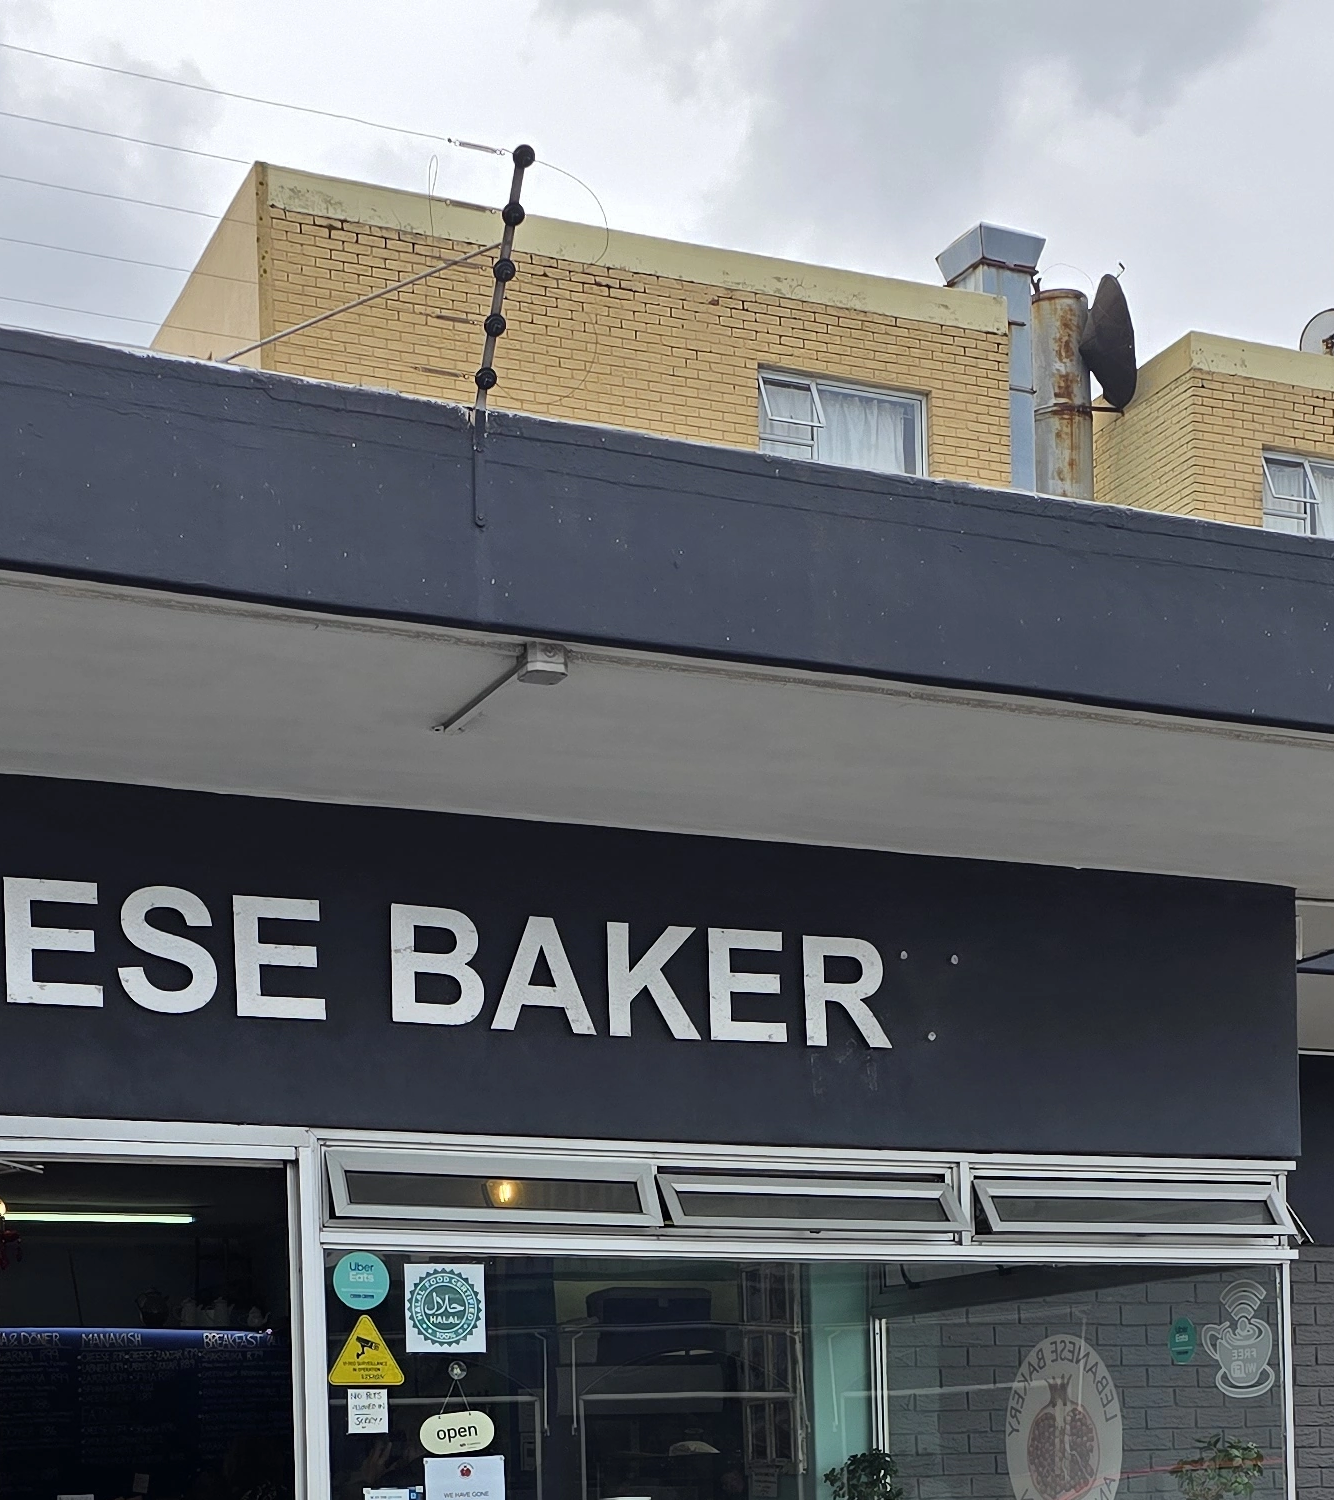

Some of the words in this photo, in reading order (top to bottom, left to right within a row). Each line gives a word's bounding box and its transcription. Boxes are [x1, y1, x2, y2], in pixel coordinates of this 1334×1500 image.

[390, 903, 893, 1049] BAKER
[349, 1261, 375, 1272] Uber
[349, 1272, 375, 1283] Eats
[424, 1276, 450, 1289] FOOD
[424, 1291, 465, 1315] حلال
[429, 1315, 462, 1325] HALAL
[80, 1332, 143, 1348] MANAKISH
[203, 1333, 265, 1349] BREAKFAST
[436, 1425, 478, 1443] open
[471, 1490, 490, 1498] GONE
